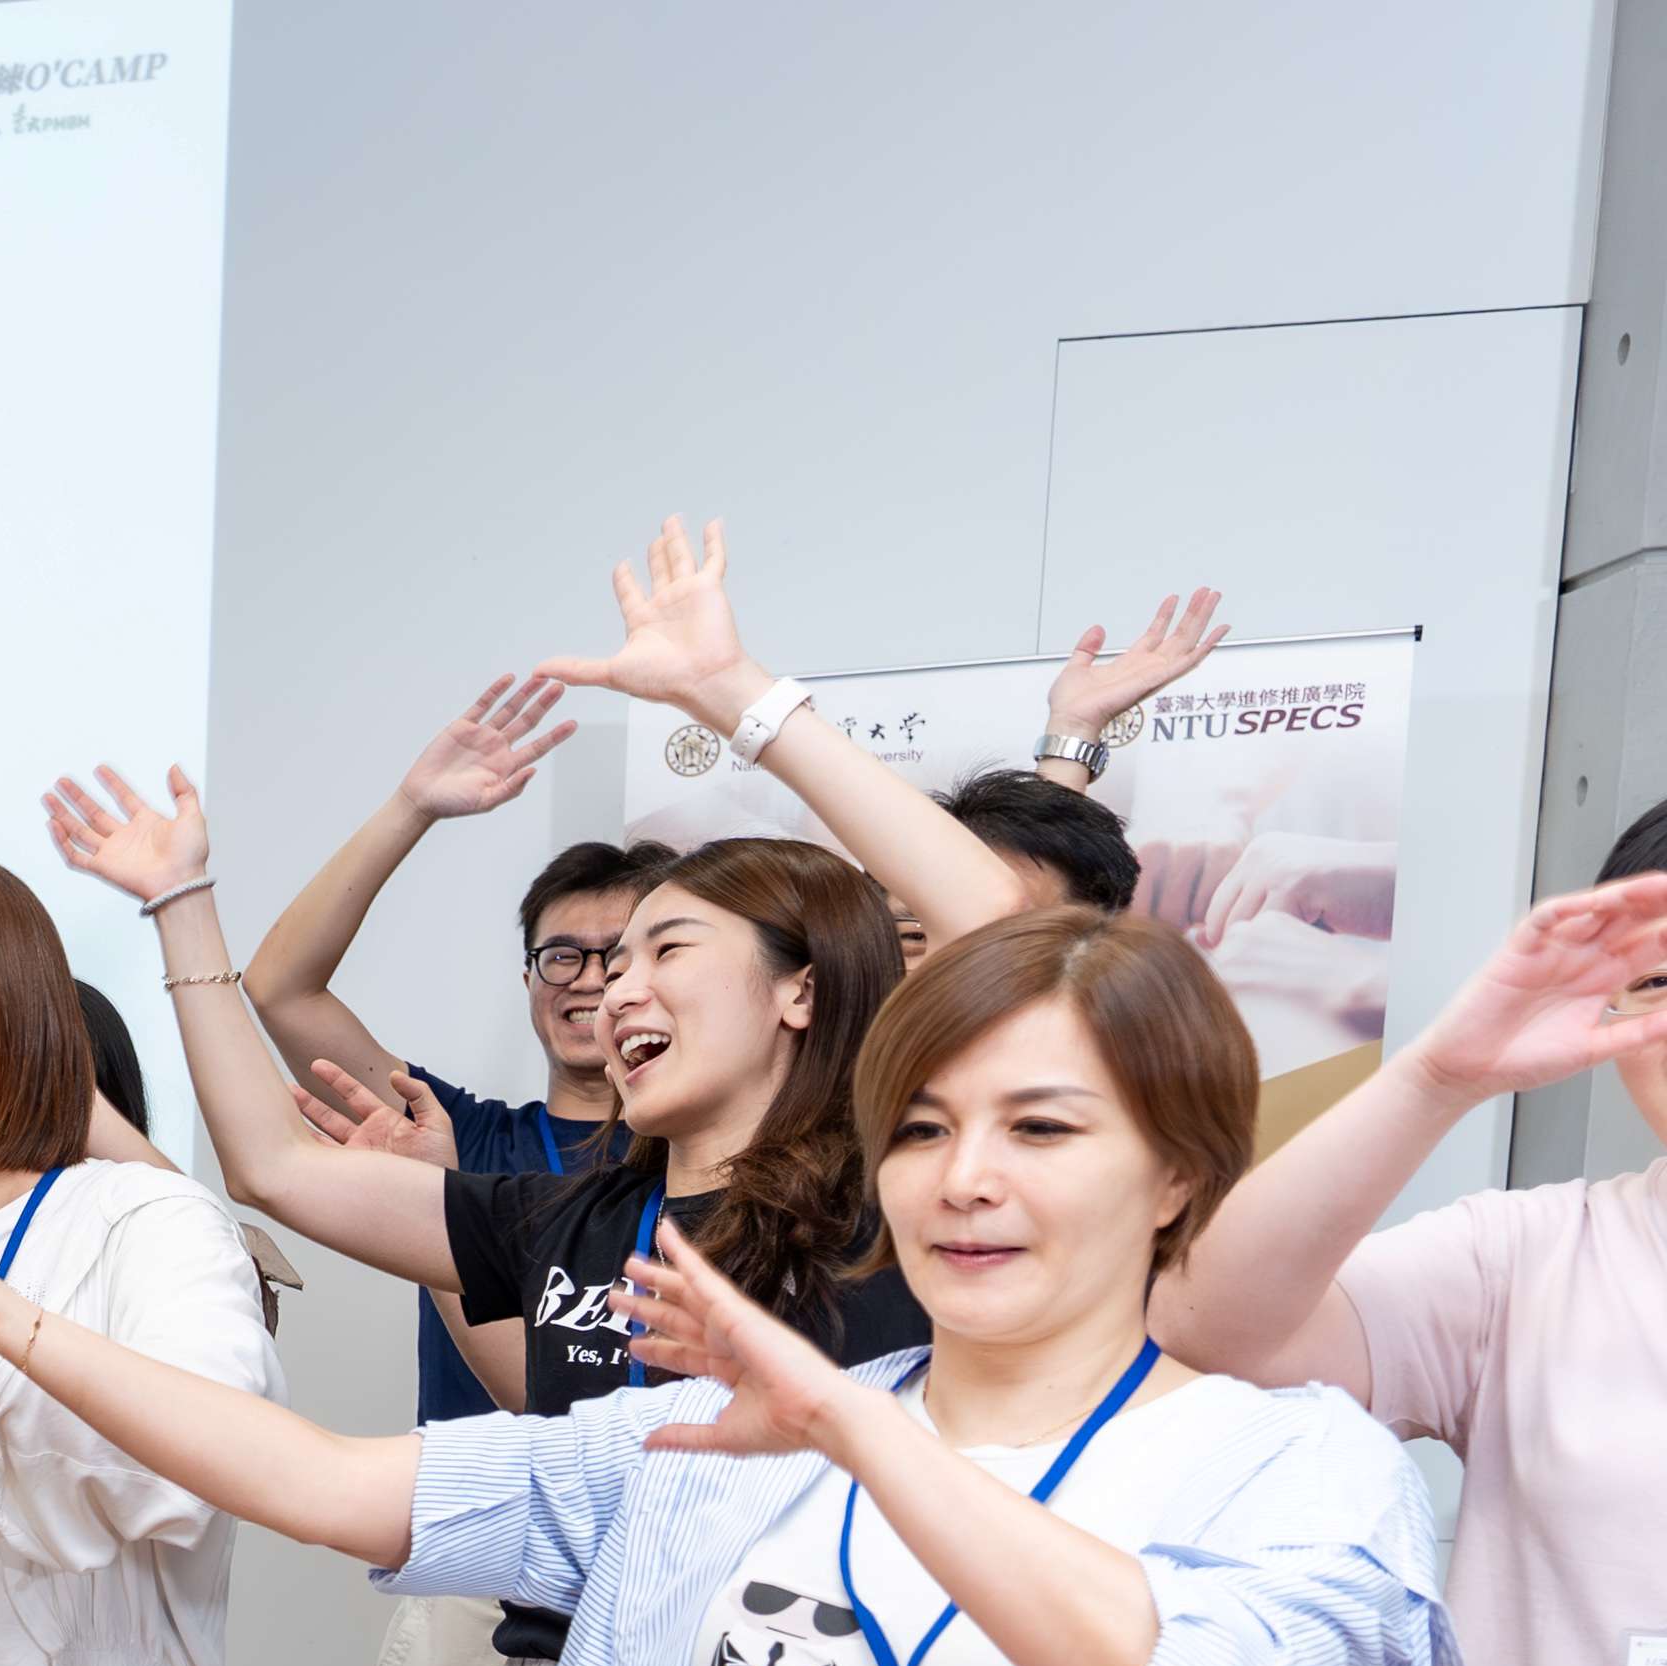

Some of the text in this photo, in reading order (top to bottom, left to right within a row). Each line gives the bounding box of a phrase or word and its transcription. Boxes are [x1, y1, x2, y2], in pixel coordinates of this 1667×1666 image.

[1154, 683, 1366, 713] 臺灣大學進修推廣學院
[1151, 703, 1364, 743] NTU SPECS
[567, 1345, 603, 1366] Yes,
